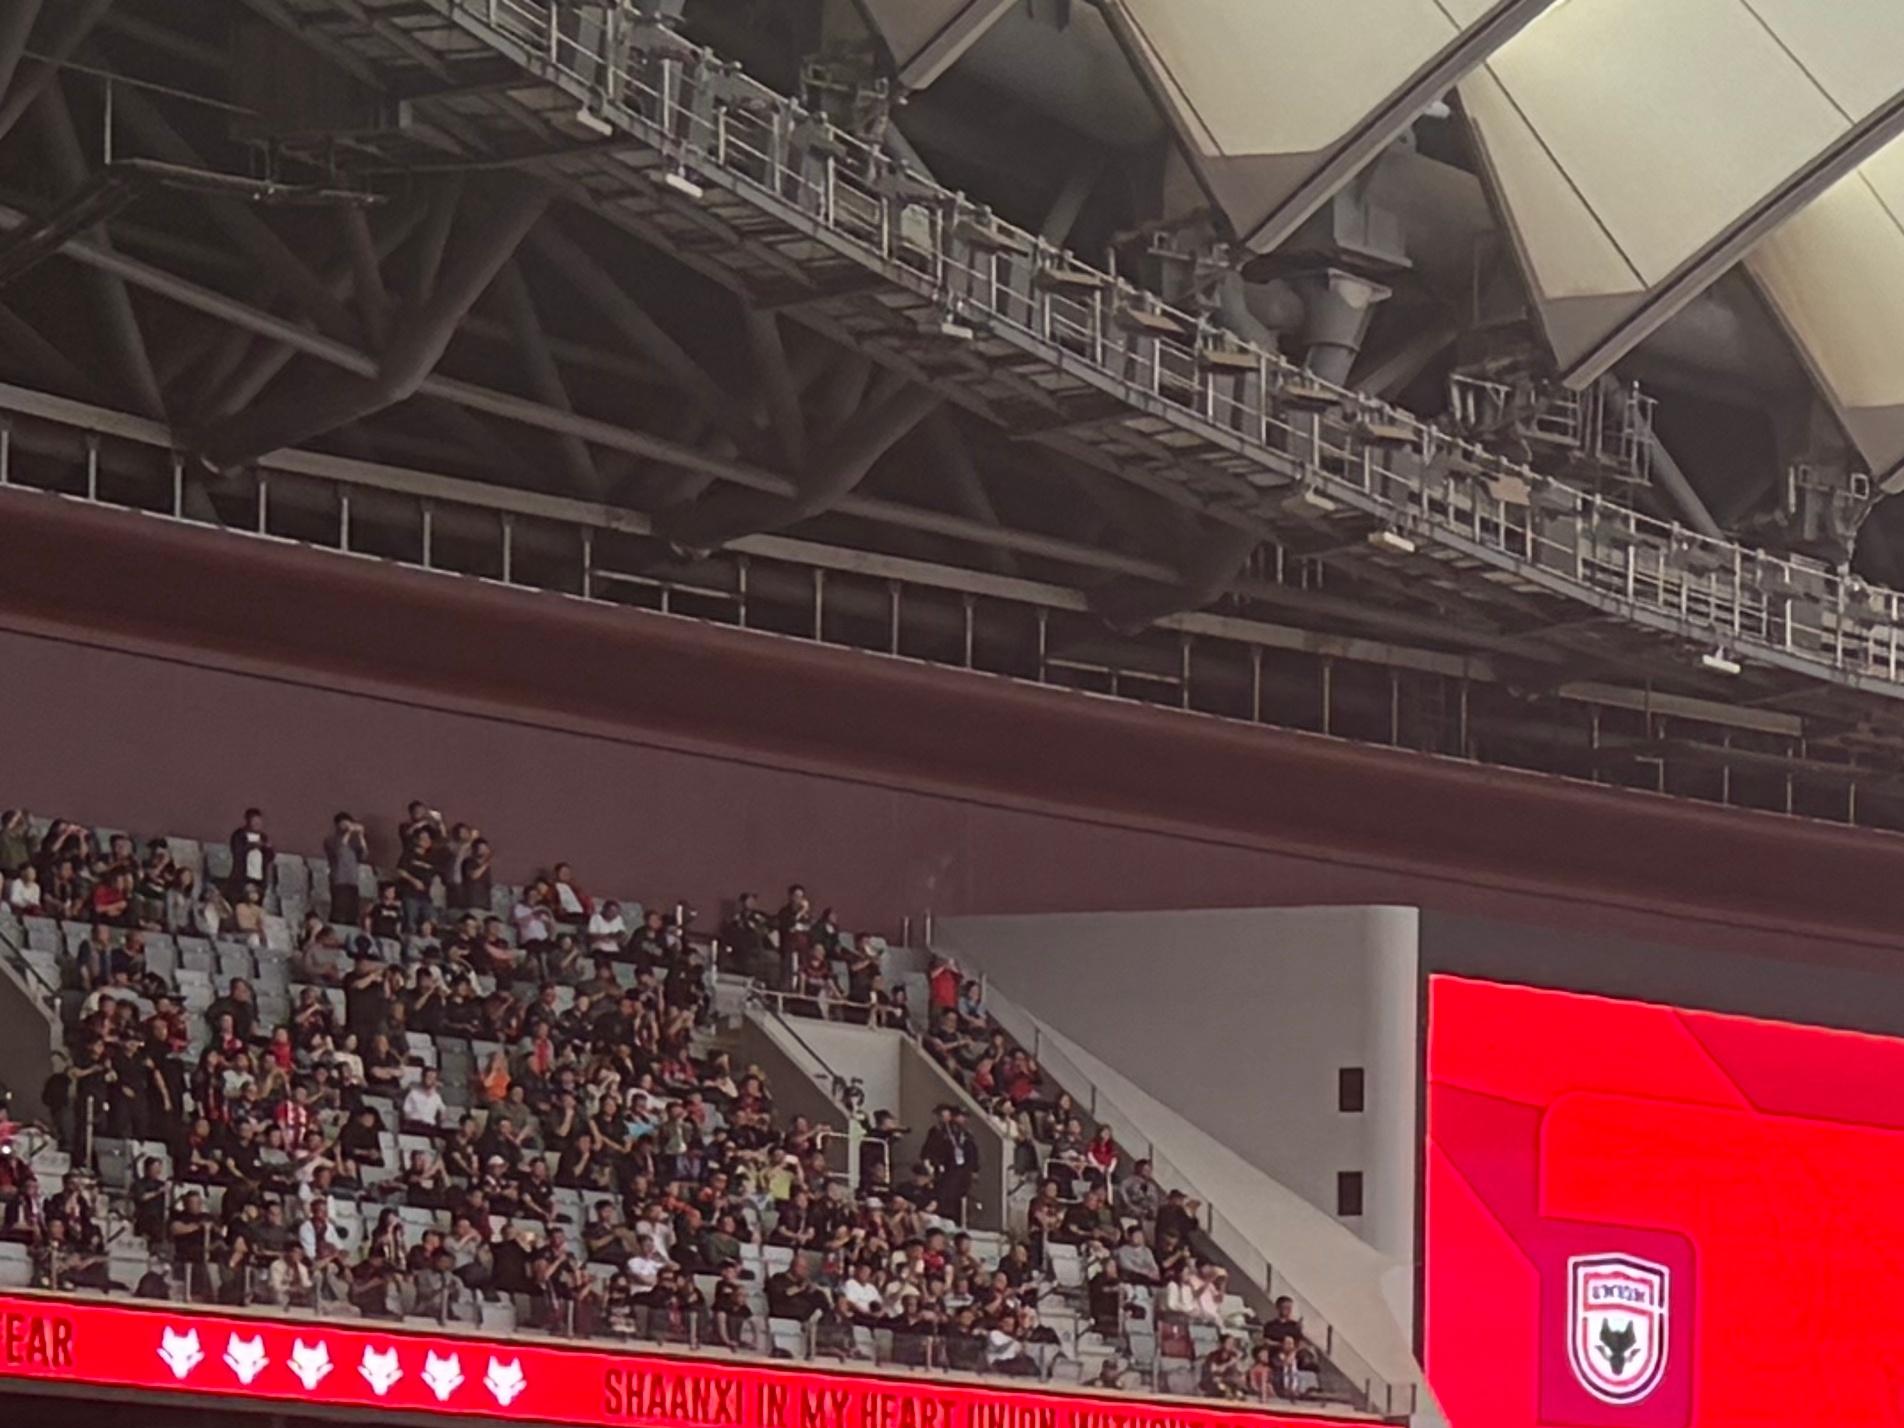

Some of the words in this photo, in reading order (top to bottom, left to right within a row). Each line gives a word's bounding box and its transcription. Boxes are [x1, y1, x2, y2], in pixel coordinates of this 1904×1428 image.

[0, 1312, 73, 1368] EAR
[604, 1367, 744, 1425] SHAANXI
[756, 1381, 787, 1428] IN
